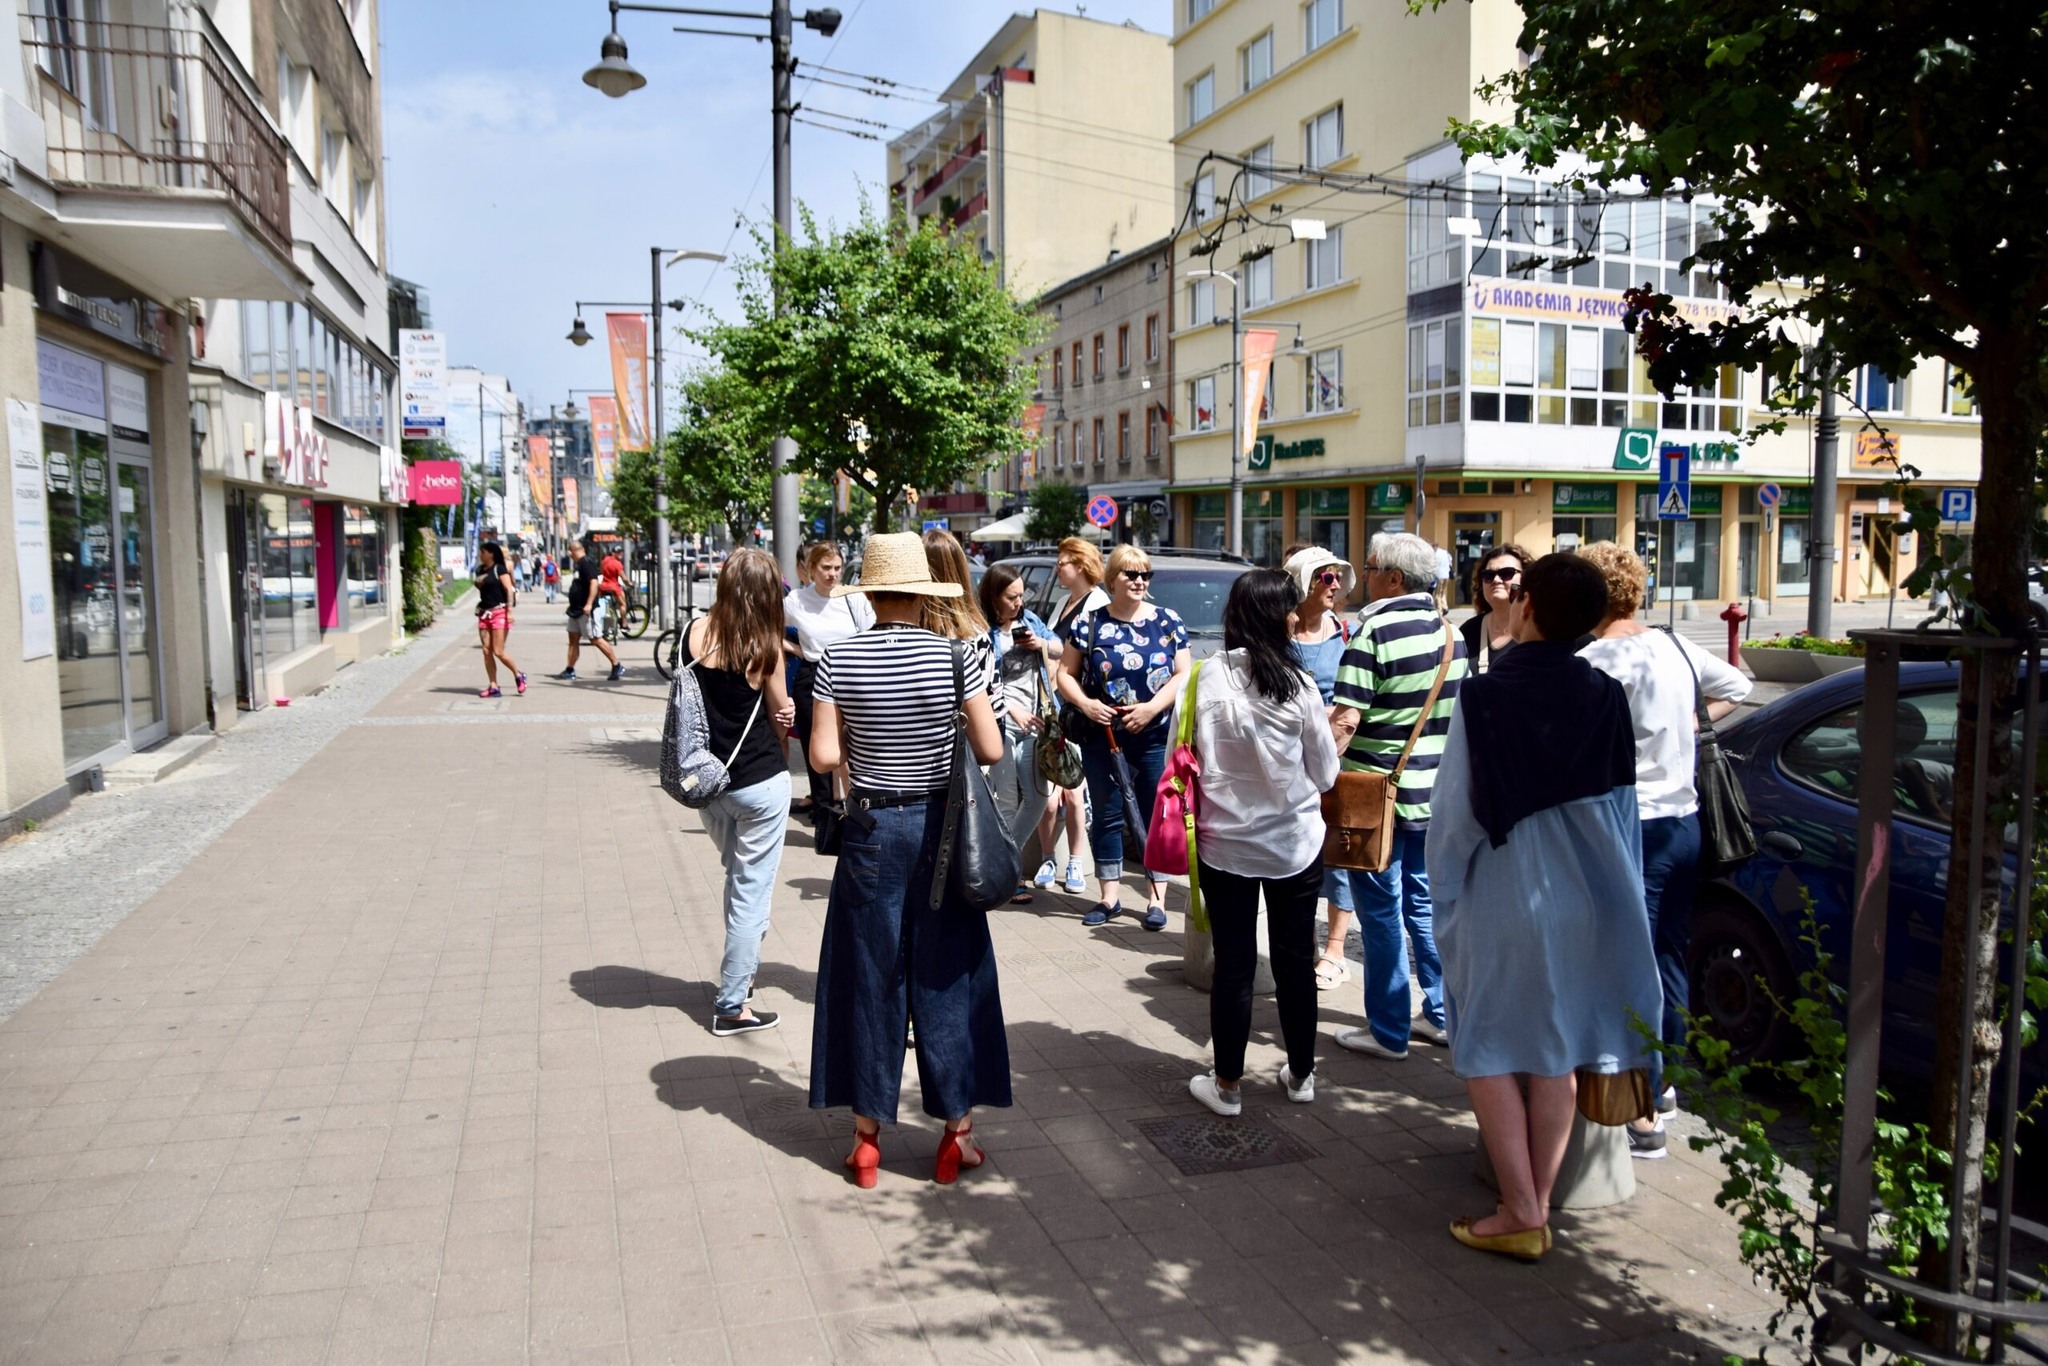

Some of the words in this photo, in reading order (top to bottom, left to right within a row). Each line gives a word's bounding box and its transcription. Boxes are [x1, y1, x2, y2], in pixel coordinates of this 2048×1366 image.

[1492, 288, 1571, 312] AKADEMIA
[1684, 303, 1699, 316] 78
[1704, 305, 1717, 317] 15
[1704, 442, 1739, 463] BPS
[426, 474, 457, 487] hebe
[1572, 490, 1592, 501] Bank
[1593, 490, 1610, 501] BPS
[1947, 492, 1967, 518] P
